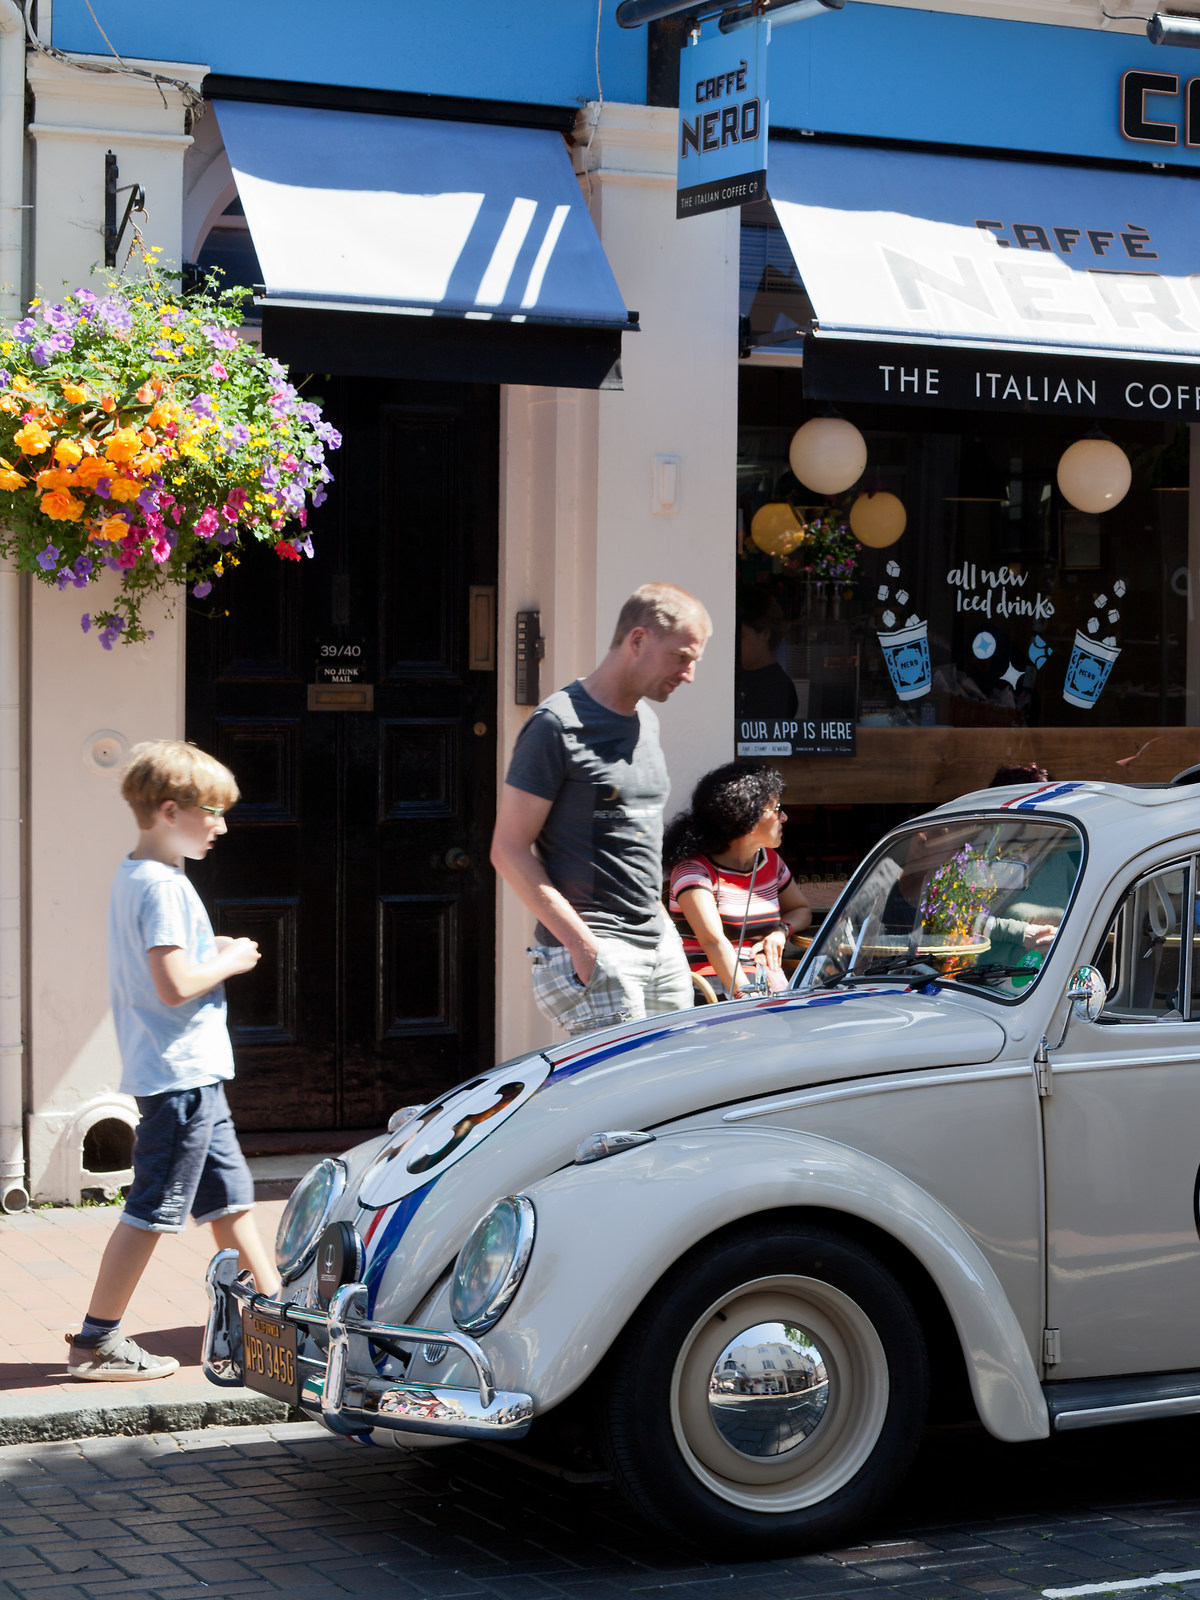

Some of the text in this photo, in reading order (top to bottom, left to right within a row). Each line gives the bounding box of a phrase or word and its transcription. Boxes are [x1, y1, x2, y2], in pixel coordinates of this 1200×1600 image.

[695, 59, 748, 104] CAFFÈ
[681, 97, 760, 158] NERO
[681, 198, 693, 208] THE
[695, 191, 720, 206] ITALIAN
[722, 185, 747, 200] COFFEE
[974, 219, 1159, 260] CAFFÈ
[879, 366, 940, 395] THE
[975, 372, 1097, 405] ITALIAN
[947, 561, 1029, 589] all new
[996, 587, 1056, 621] drinks
[320, 645, 361, 657] 39/40
[324, 668, 359, 676] NO JUNK
[900, 659, 919, 669] NERO
[1078, 669, 1096, 680] NERO
[331, 675, 352, 683] MAIL
[741, 721, 852, 740] OUR APP IS HERE
[254, 1318, 280, 1338] CALIFORNIA
